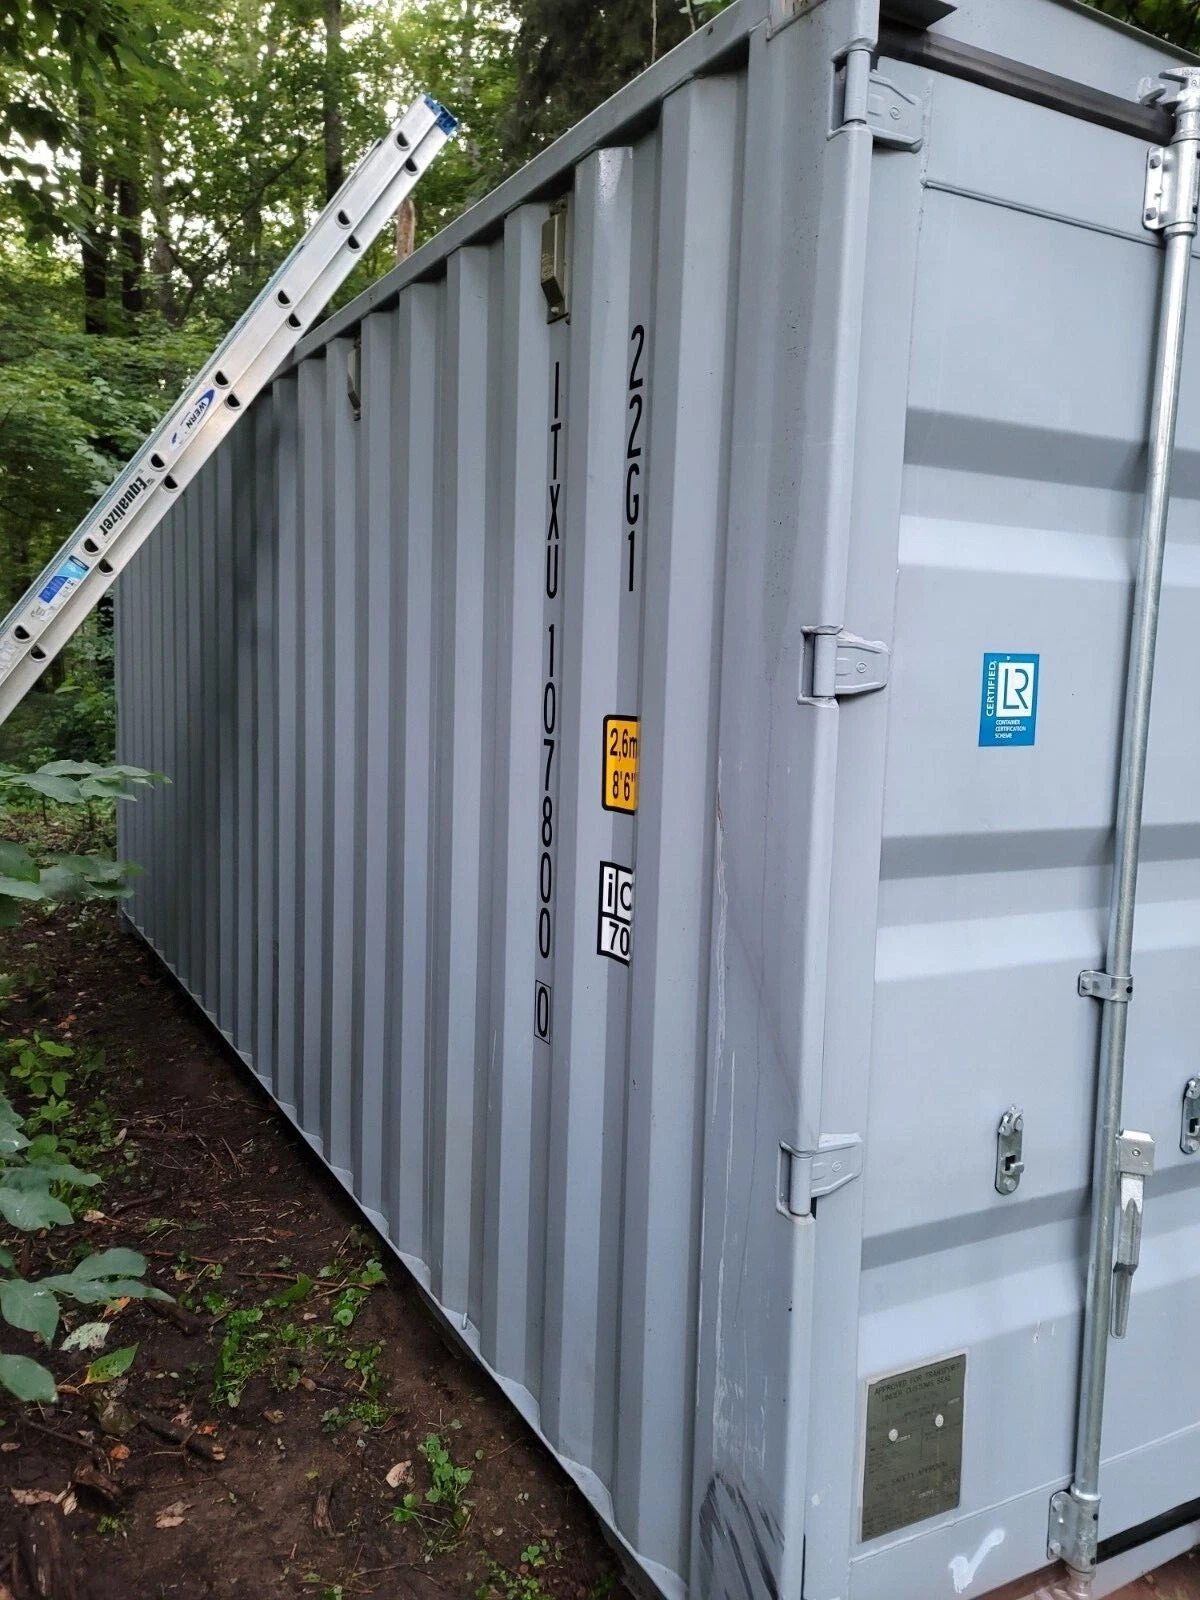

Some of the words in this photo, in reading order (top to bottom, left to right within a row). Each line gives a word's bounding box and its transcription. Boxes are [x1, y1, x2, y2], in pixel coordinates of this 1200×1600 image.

[546, 361, 562, 599] ITXU
[625, 324, 645, 592] 22G1
[100, 476, 148, 536] Equalizer
[1003, 668, 1029, 710] LR
[538, 624, 556, 959] 107800
[609, 920, 630, 956] 70
[874, 1379, 907, 1396] APPROVED
[909, 1374, 923, 1384] FOR
